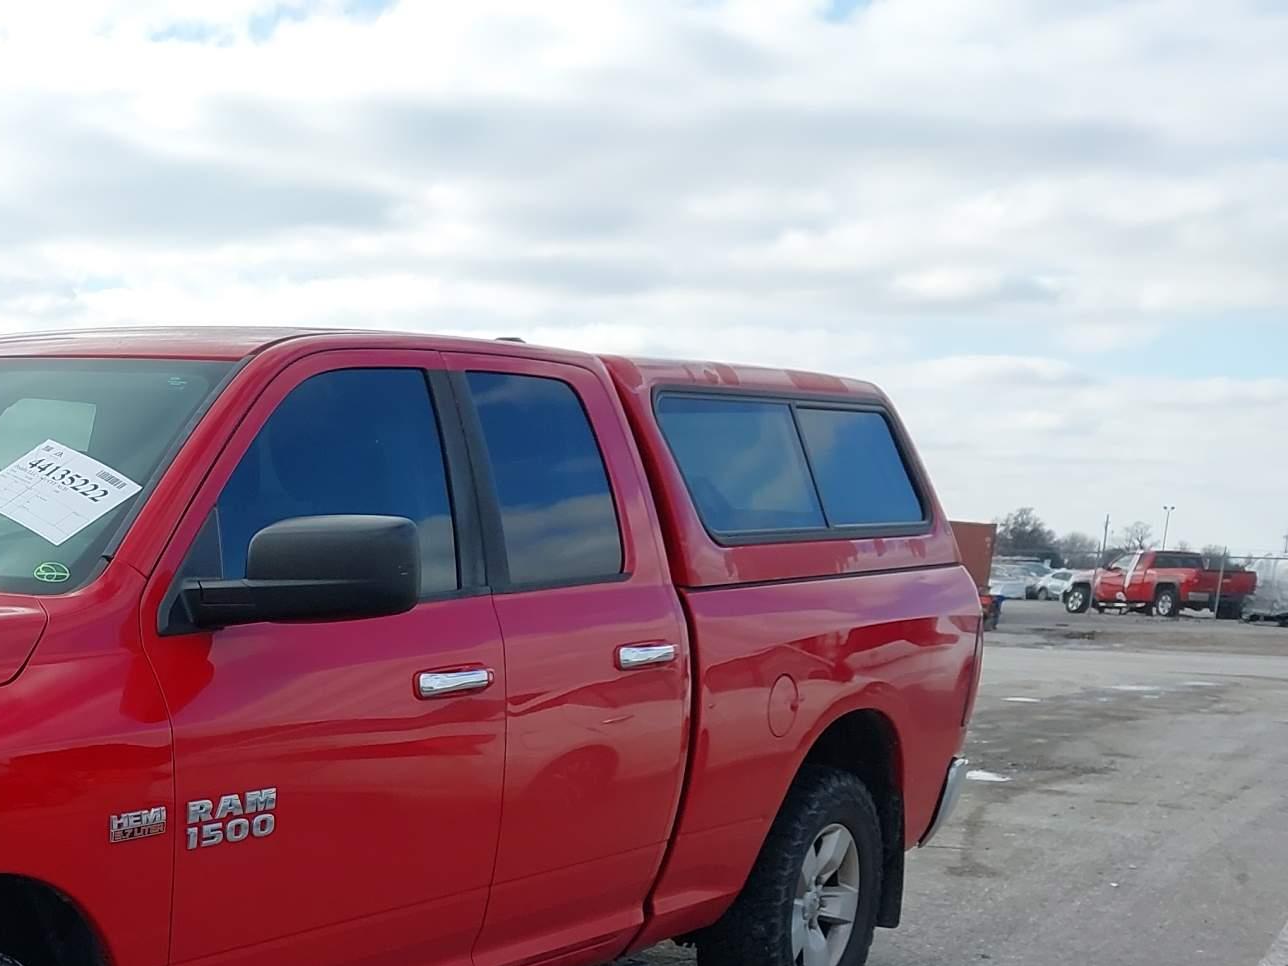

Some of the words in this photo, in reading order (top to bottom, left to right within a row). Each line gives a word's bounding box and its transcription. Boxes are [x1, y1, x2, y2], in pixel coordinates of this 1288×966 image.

[28, 458, 109, 502] 44135222
[110, 806, 166, 830] HEMI
[187, 787, 278, 825] RAM
[186, 813, 276, 850] 1500
